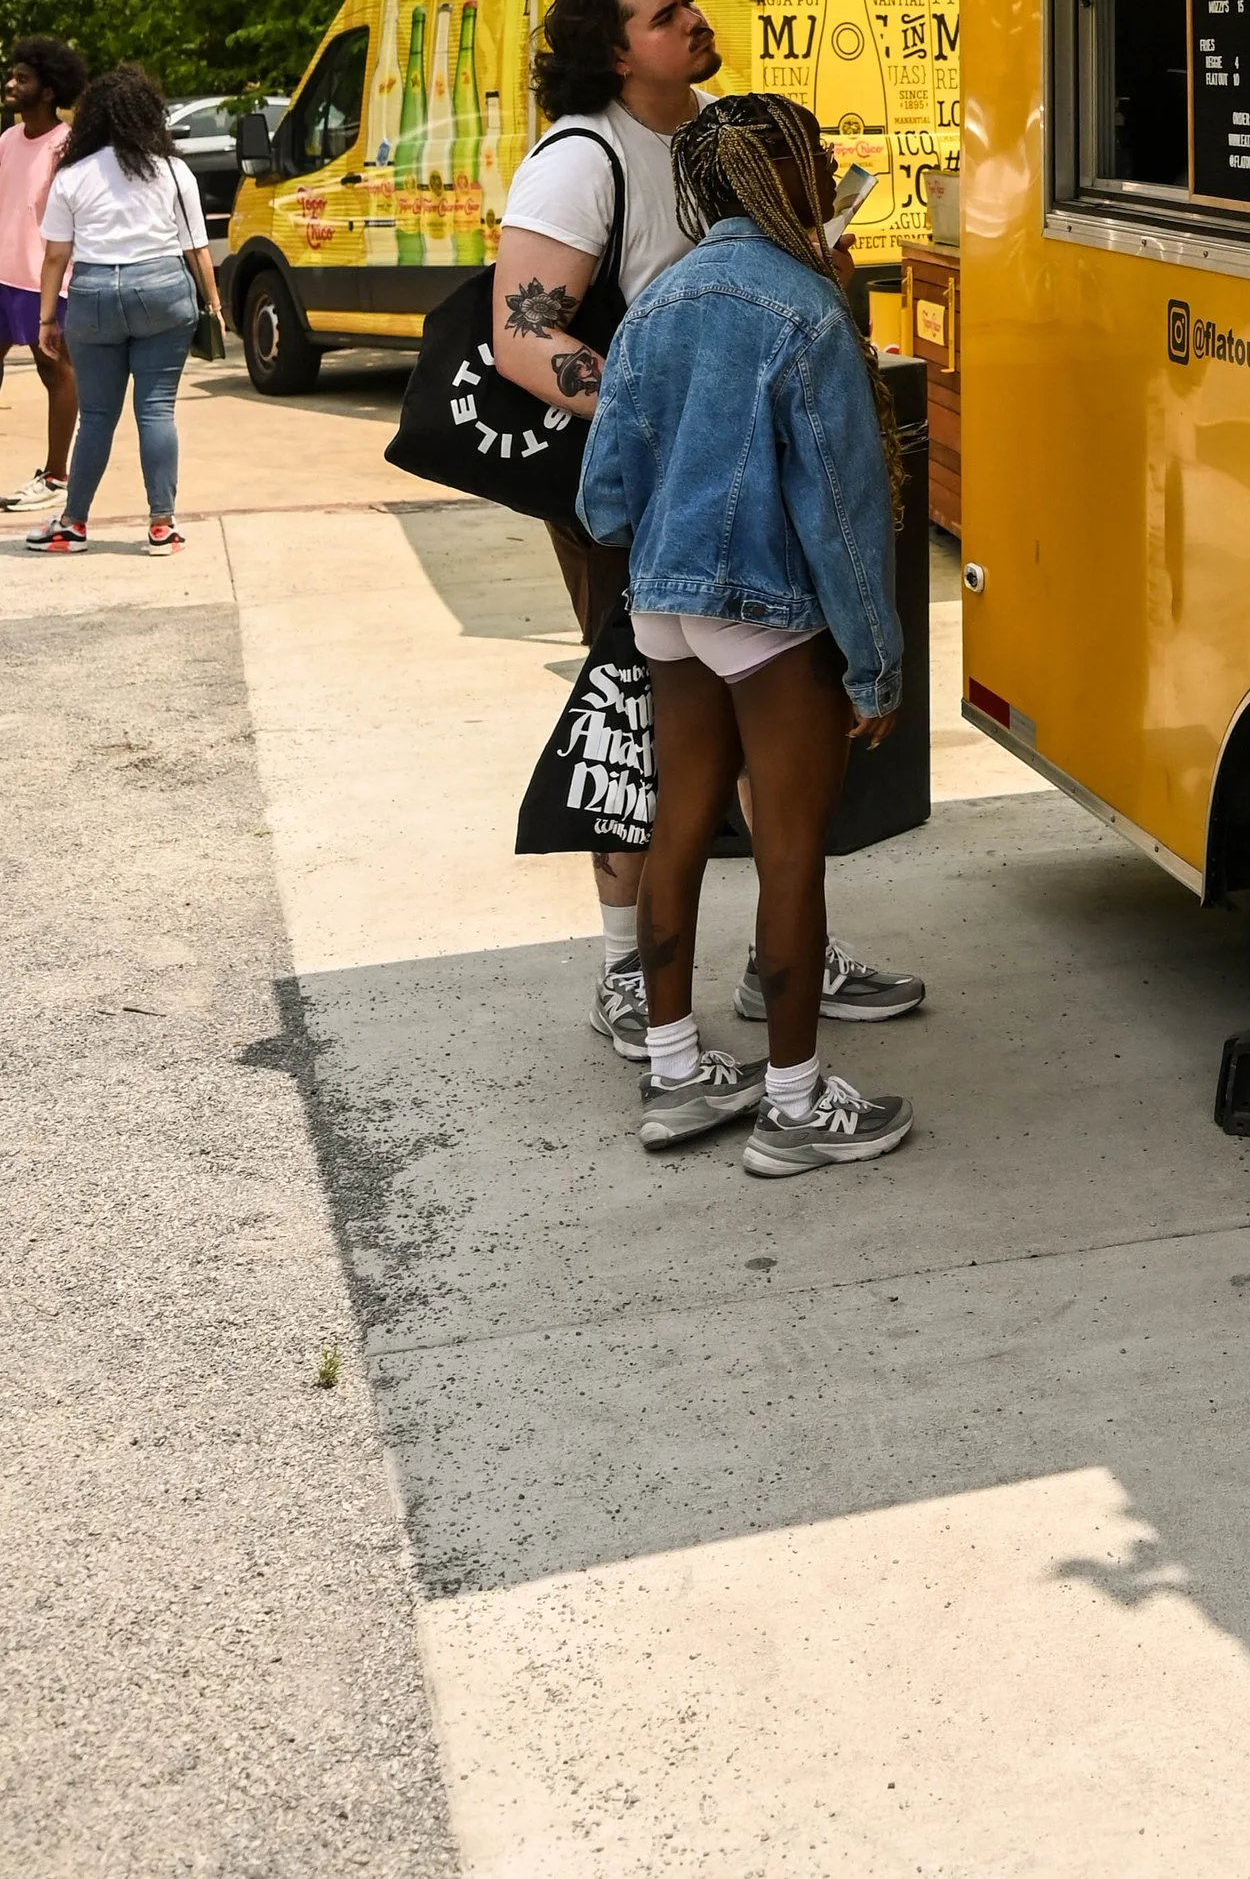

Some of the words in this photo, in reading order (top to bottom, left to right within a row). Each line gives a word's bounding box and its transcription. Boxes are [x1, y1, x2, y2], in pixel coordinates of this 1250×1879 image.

[1237, 0, 1244, 13] 15
[1200, 39, 1215, 51] FRIES
[1233, 73, 1240, 86] 10
[899, 91, 929, 100] SINCE
[1233, 112, 1250, 125] ORDER
